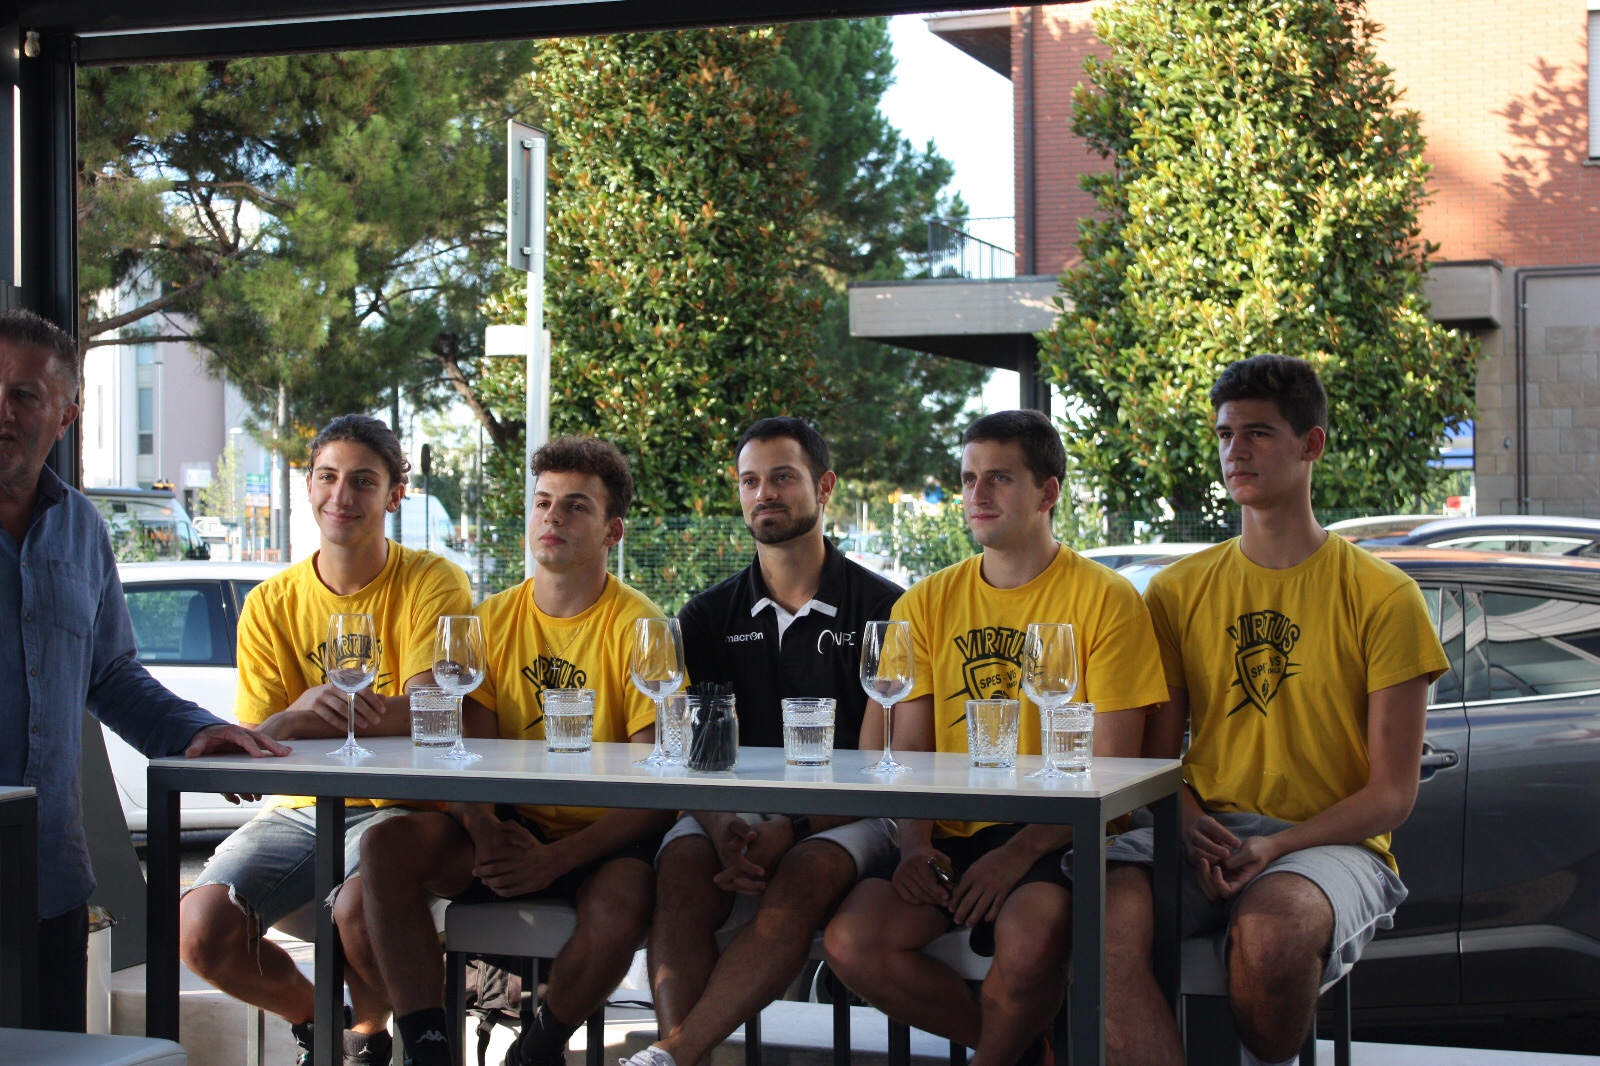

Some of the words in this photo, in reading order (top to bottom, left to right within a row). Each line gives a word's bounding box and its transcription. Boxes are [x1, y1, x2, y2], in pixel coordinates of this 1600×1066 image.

[725, 631, 764, 643] macron
[953, 626, 1043, 662] VIRTU
[1226, 610, 1301, 655] VIRTUS
[521, 654, 587, 690] VRTUS
[979, 674, 1002, 689] SPES
[1251, 663, 1268, 678] SPE
